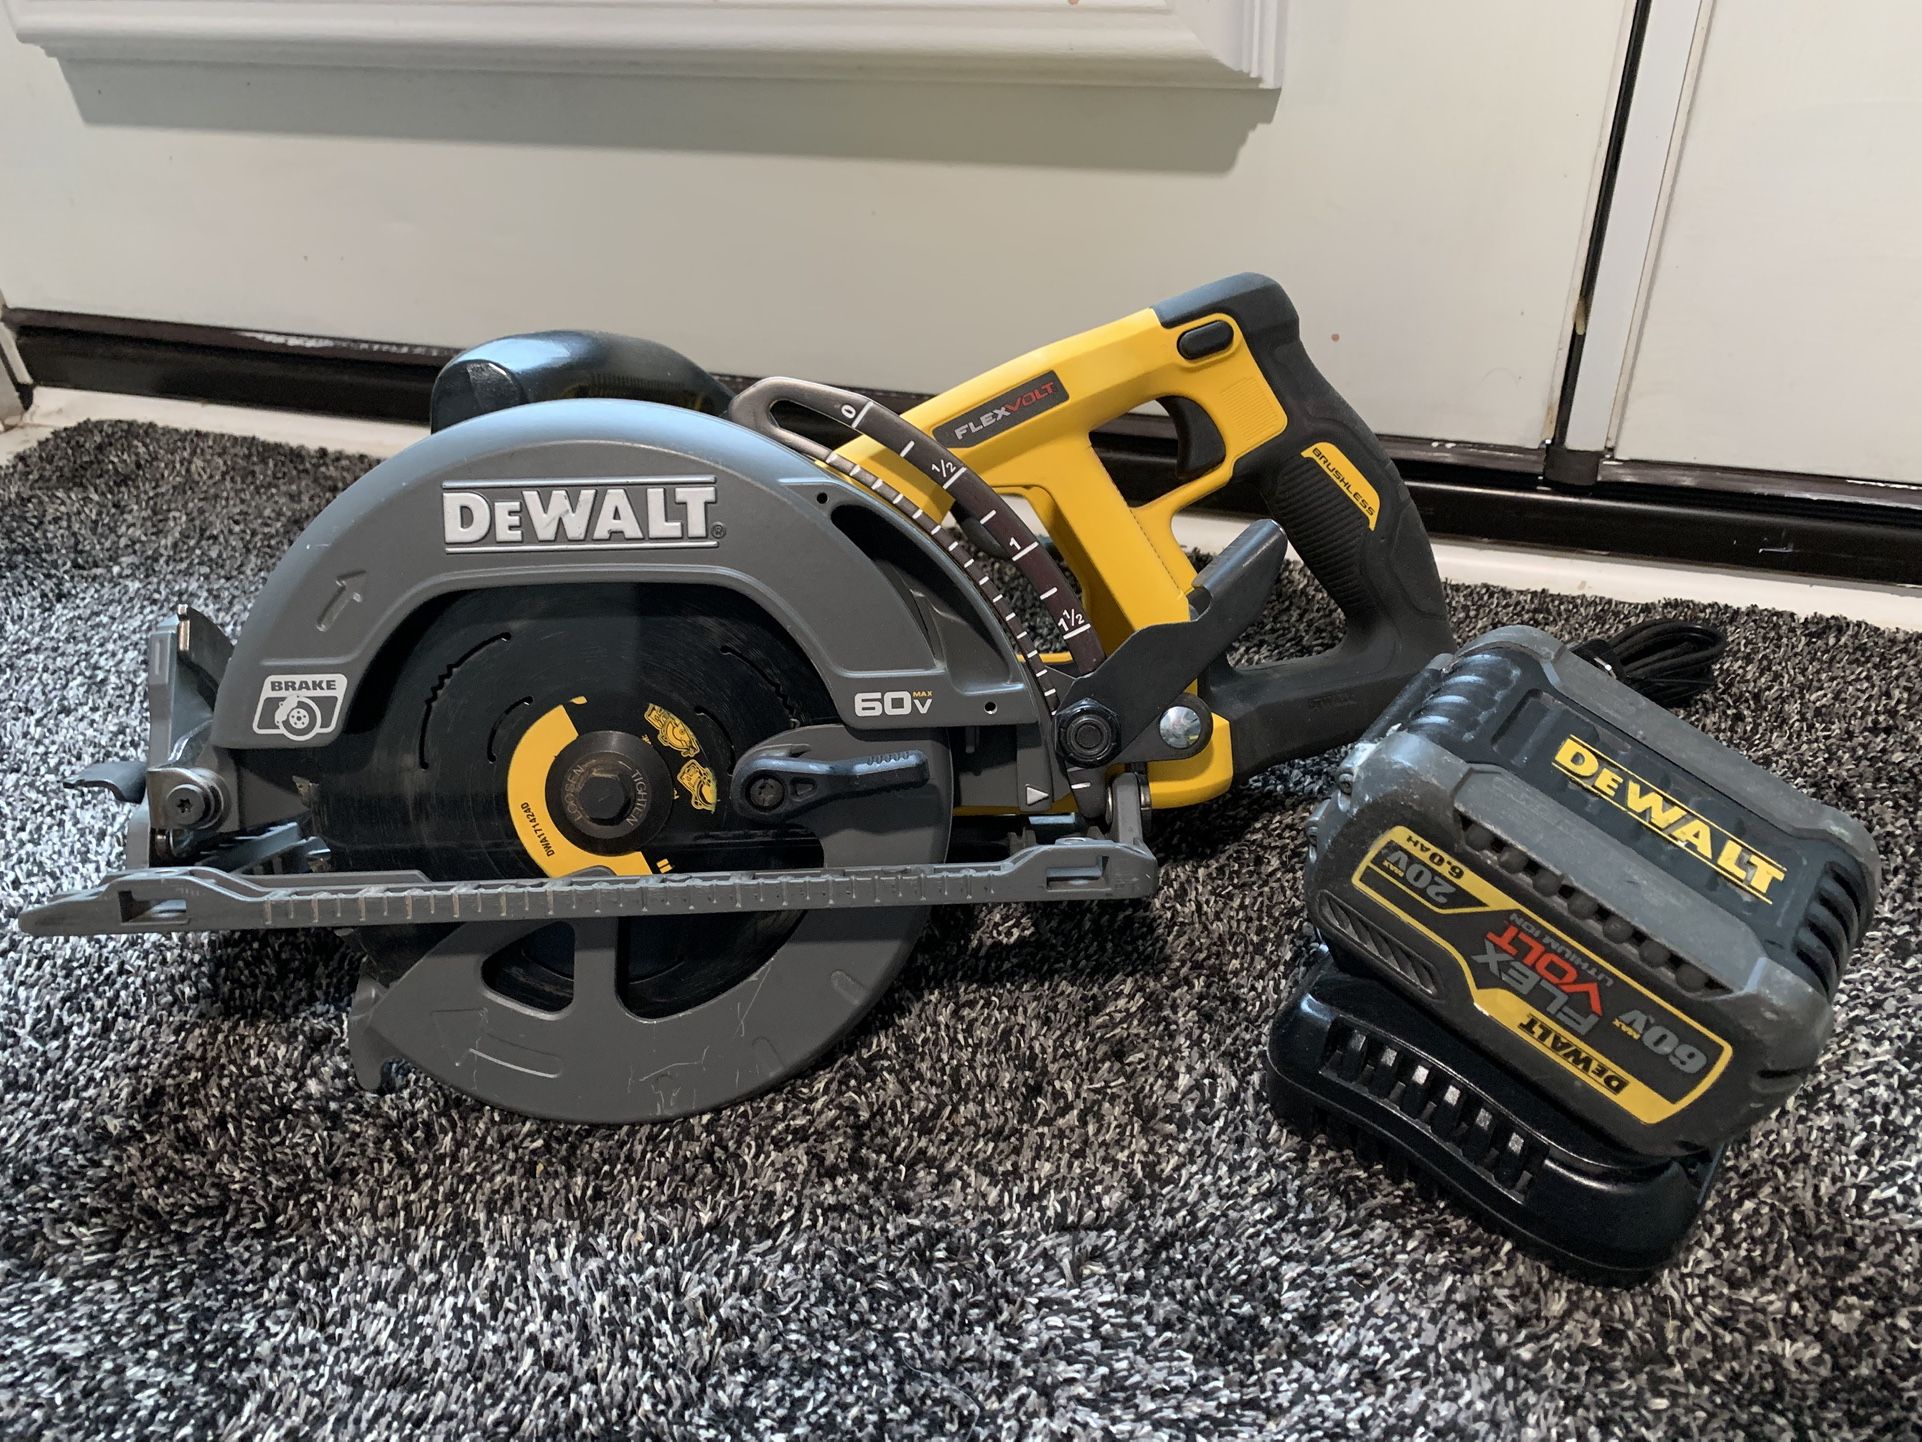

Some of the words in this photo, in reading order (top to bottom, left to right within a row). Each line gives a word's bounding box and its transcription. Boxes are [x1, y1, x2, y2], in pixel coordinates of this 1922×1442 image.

[840, 404, 857, 419] 0
[954, 382, 1054, 440] FLEXVOLT
[1312, 447, 1376, 517] BRUSHLESS
[1009, 537, 1022, 550] 1
[271, 680, 337, 692] BRAKE
[912, 690, 934, 698] MAX
[564, 764, 585, 822] LOOSEN
[626, 769, 649, 827] TIGHTEN
[1554, 738, 1786, 894] DEWALT
[520, 802, 556, 857] DWA171424D
[1471, 938, 1601, 1035] FLEX
[1486, 923, 1603, 1017] VOLT
[1518, 1015, 1629, 1095] DEWALT
[1611, 1016, 1642, 1041] MAX
